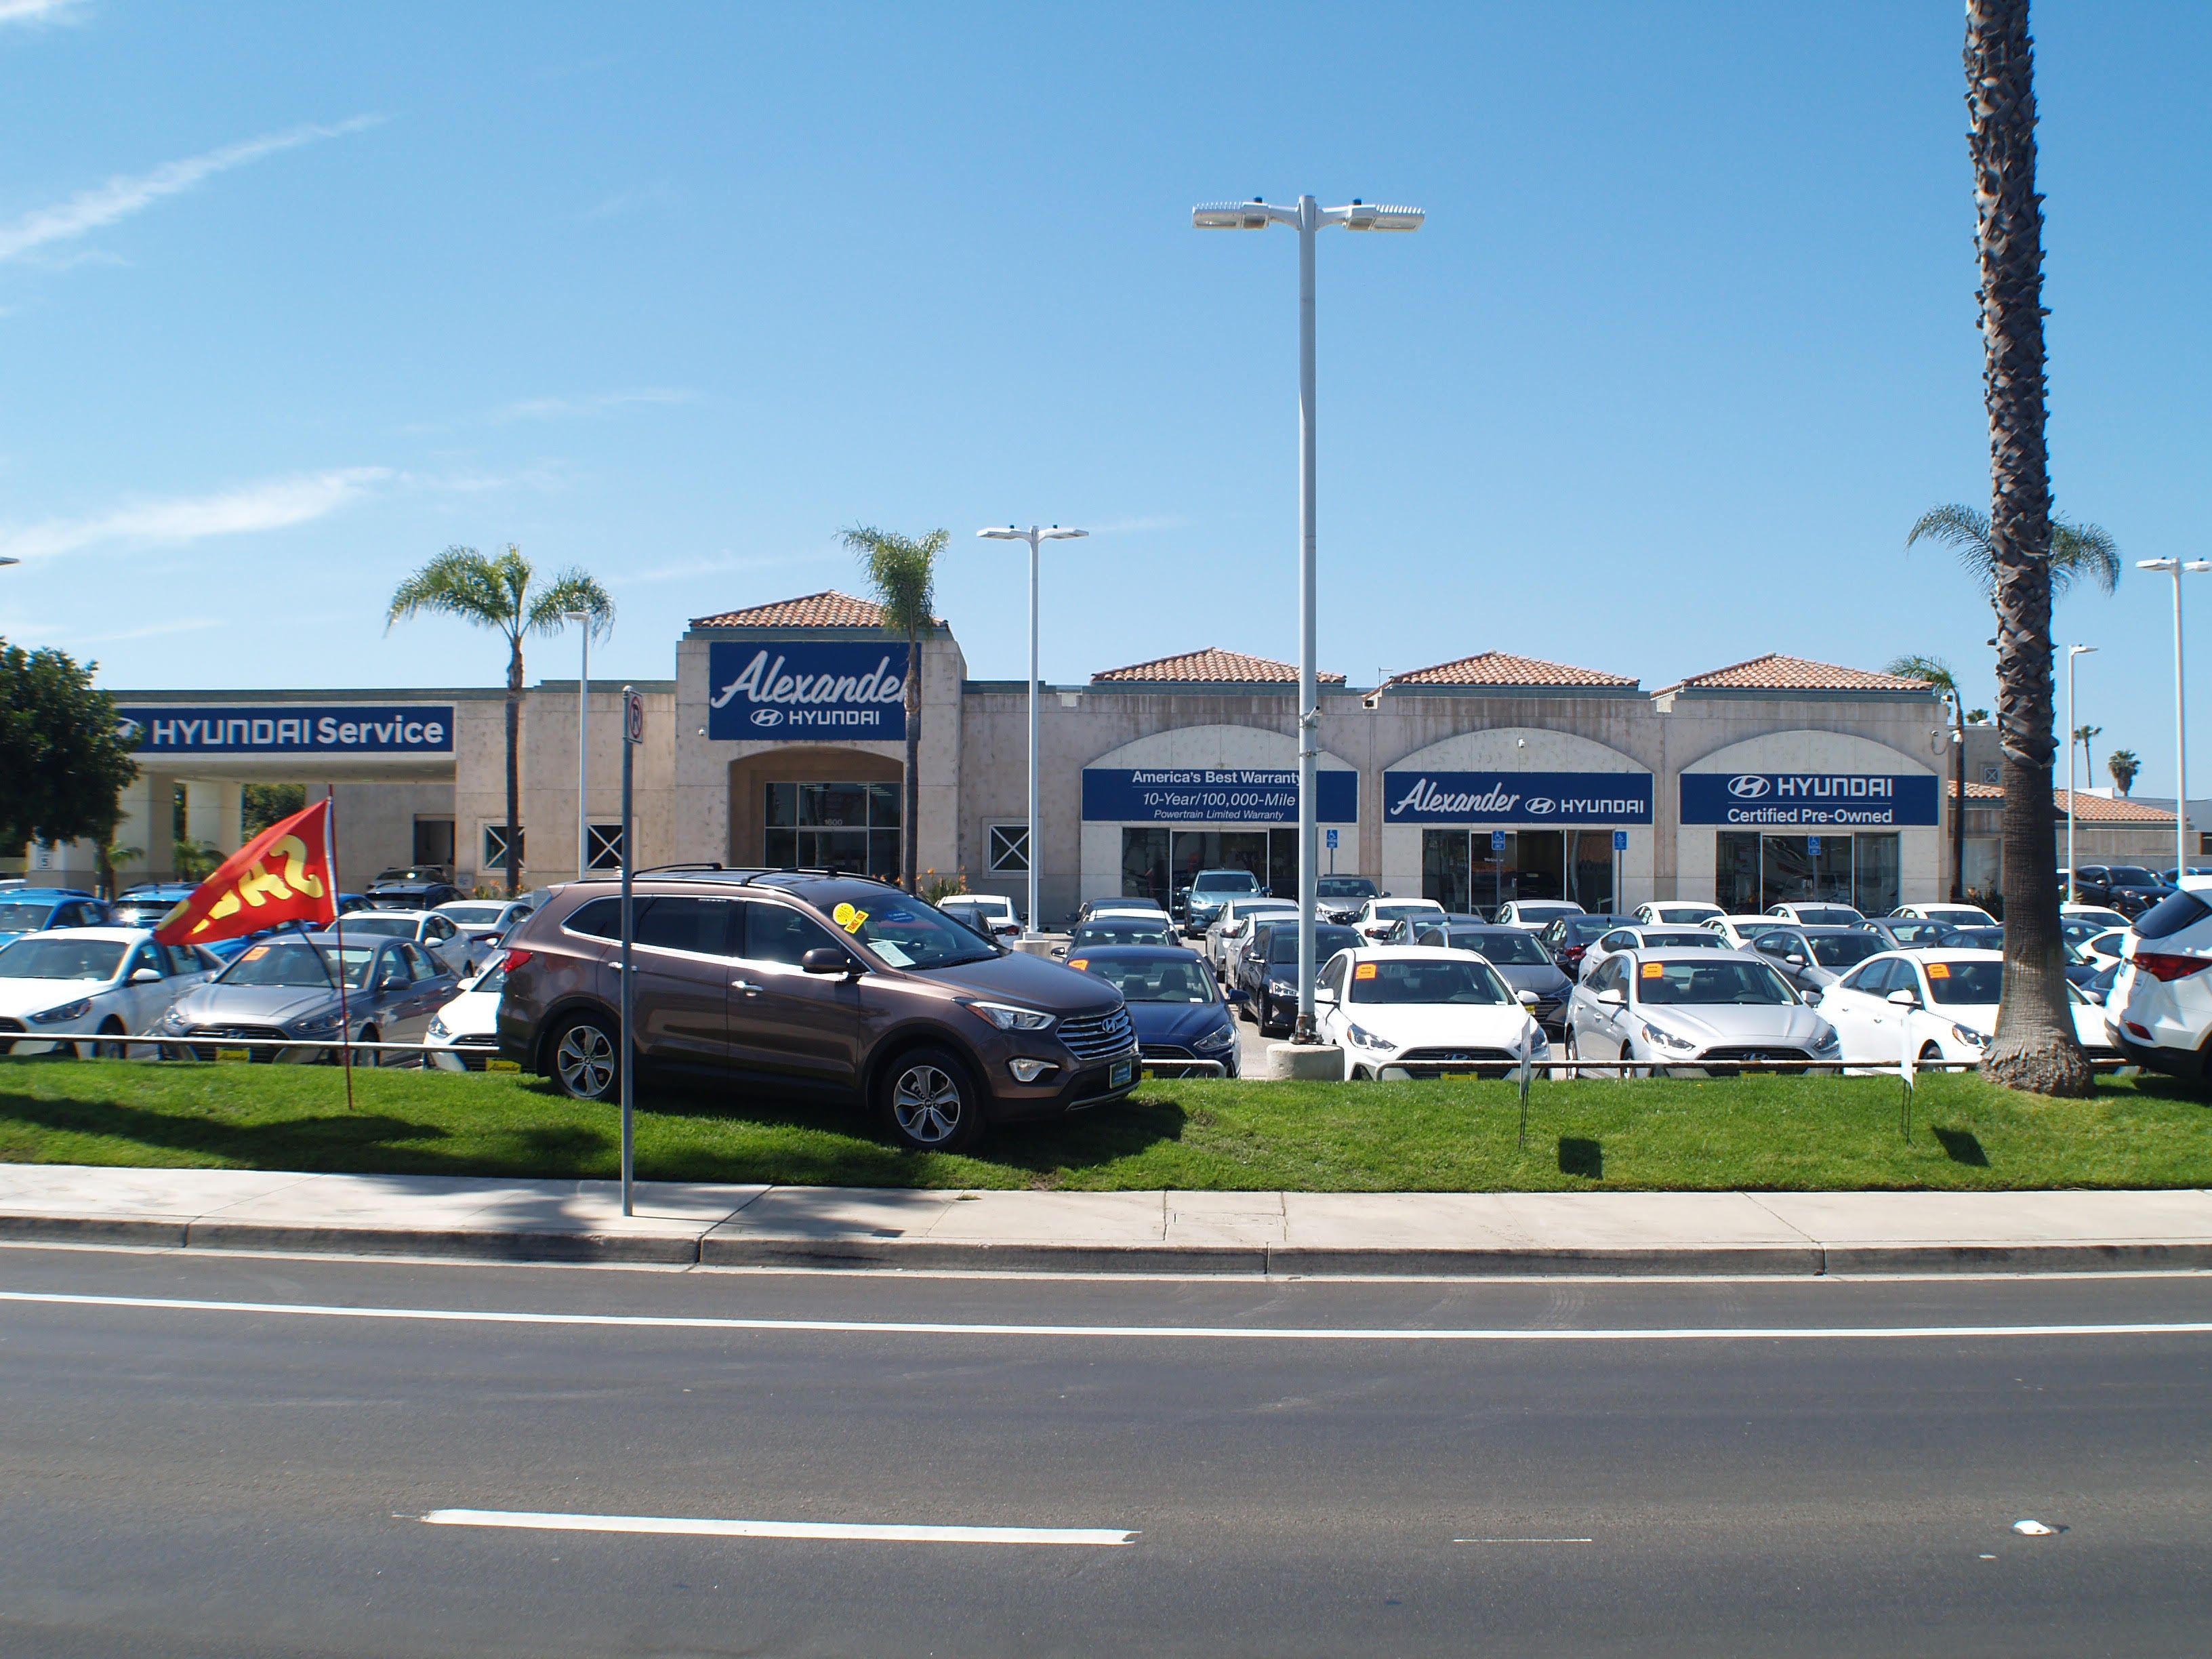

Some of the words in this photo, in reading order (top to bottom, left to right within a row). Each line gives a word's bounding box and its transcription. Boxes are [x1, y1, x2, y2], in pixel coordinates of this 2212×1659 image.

[789, 710, 880, 725] HYUNDAI
[152, 718, 310, 745] HYUNDAI
[316, 714, 444, 744] Service
[1131, 771, 1202, 783] America's
[1205, 771, 1238, 783] Best
[1778, 777, 1893, 797] HYUNDAI
[1143, 792, 1296, 807] 10-Year/100,000-Mile
[1390, 778, 1521, 815] Alexander
[1561, 799, 1644, 813] HYUNDAI
[1153, 809, 1204, 819] Powertrain
[1206, 809, 1242, 819] Limited
[1244, 810, 1284, 821] Warranty
[1727, 807, 1798, 823] Certified
[1802, 808, 1893, 823] Pre-Owned
